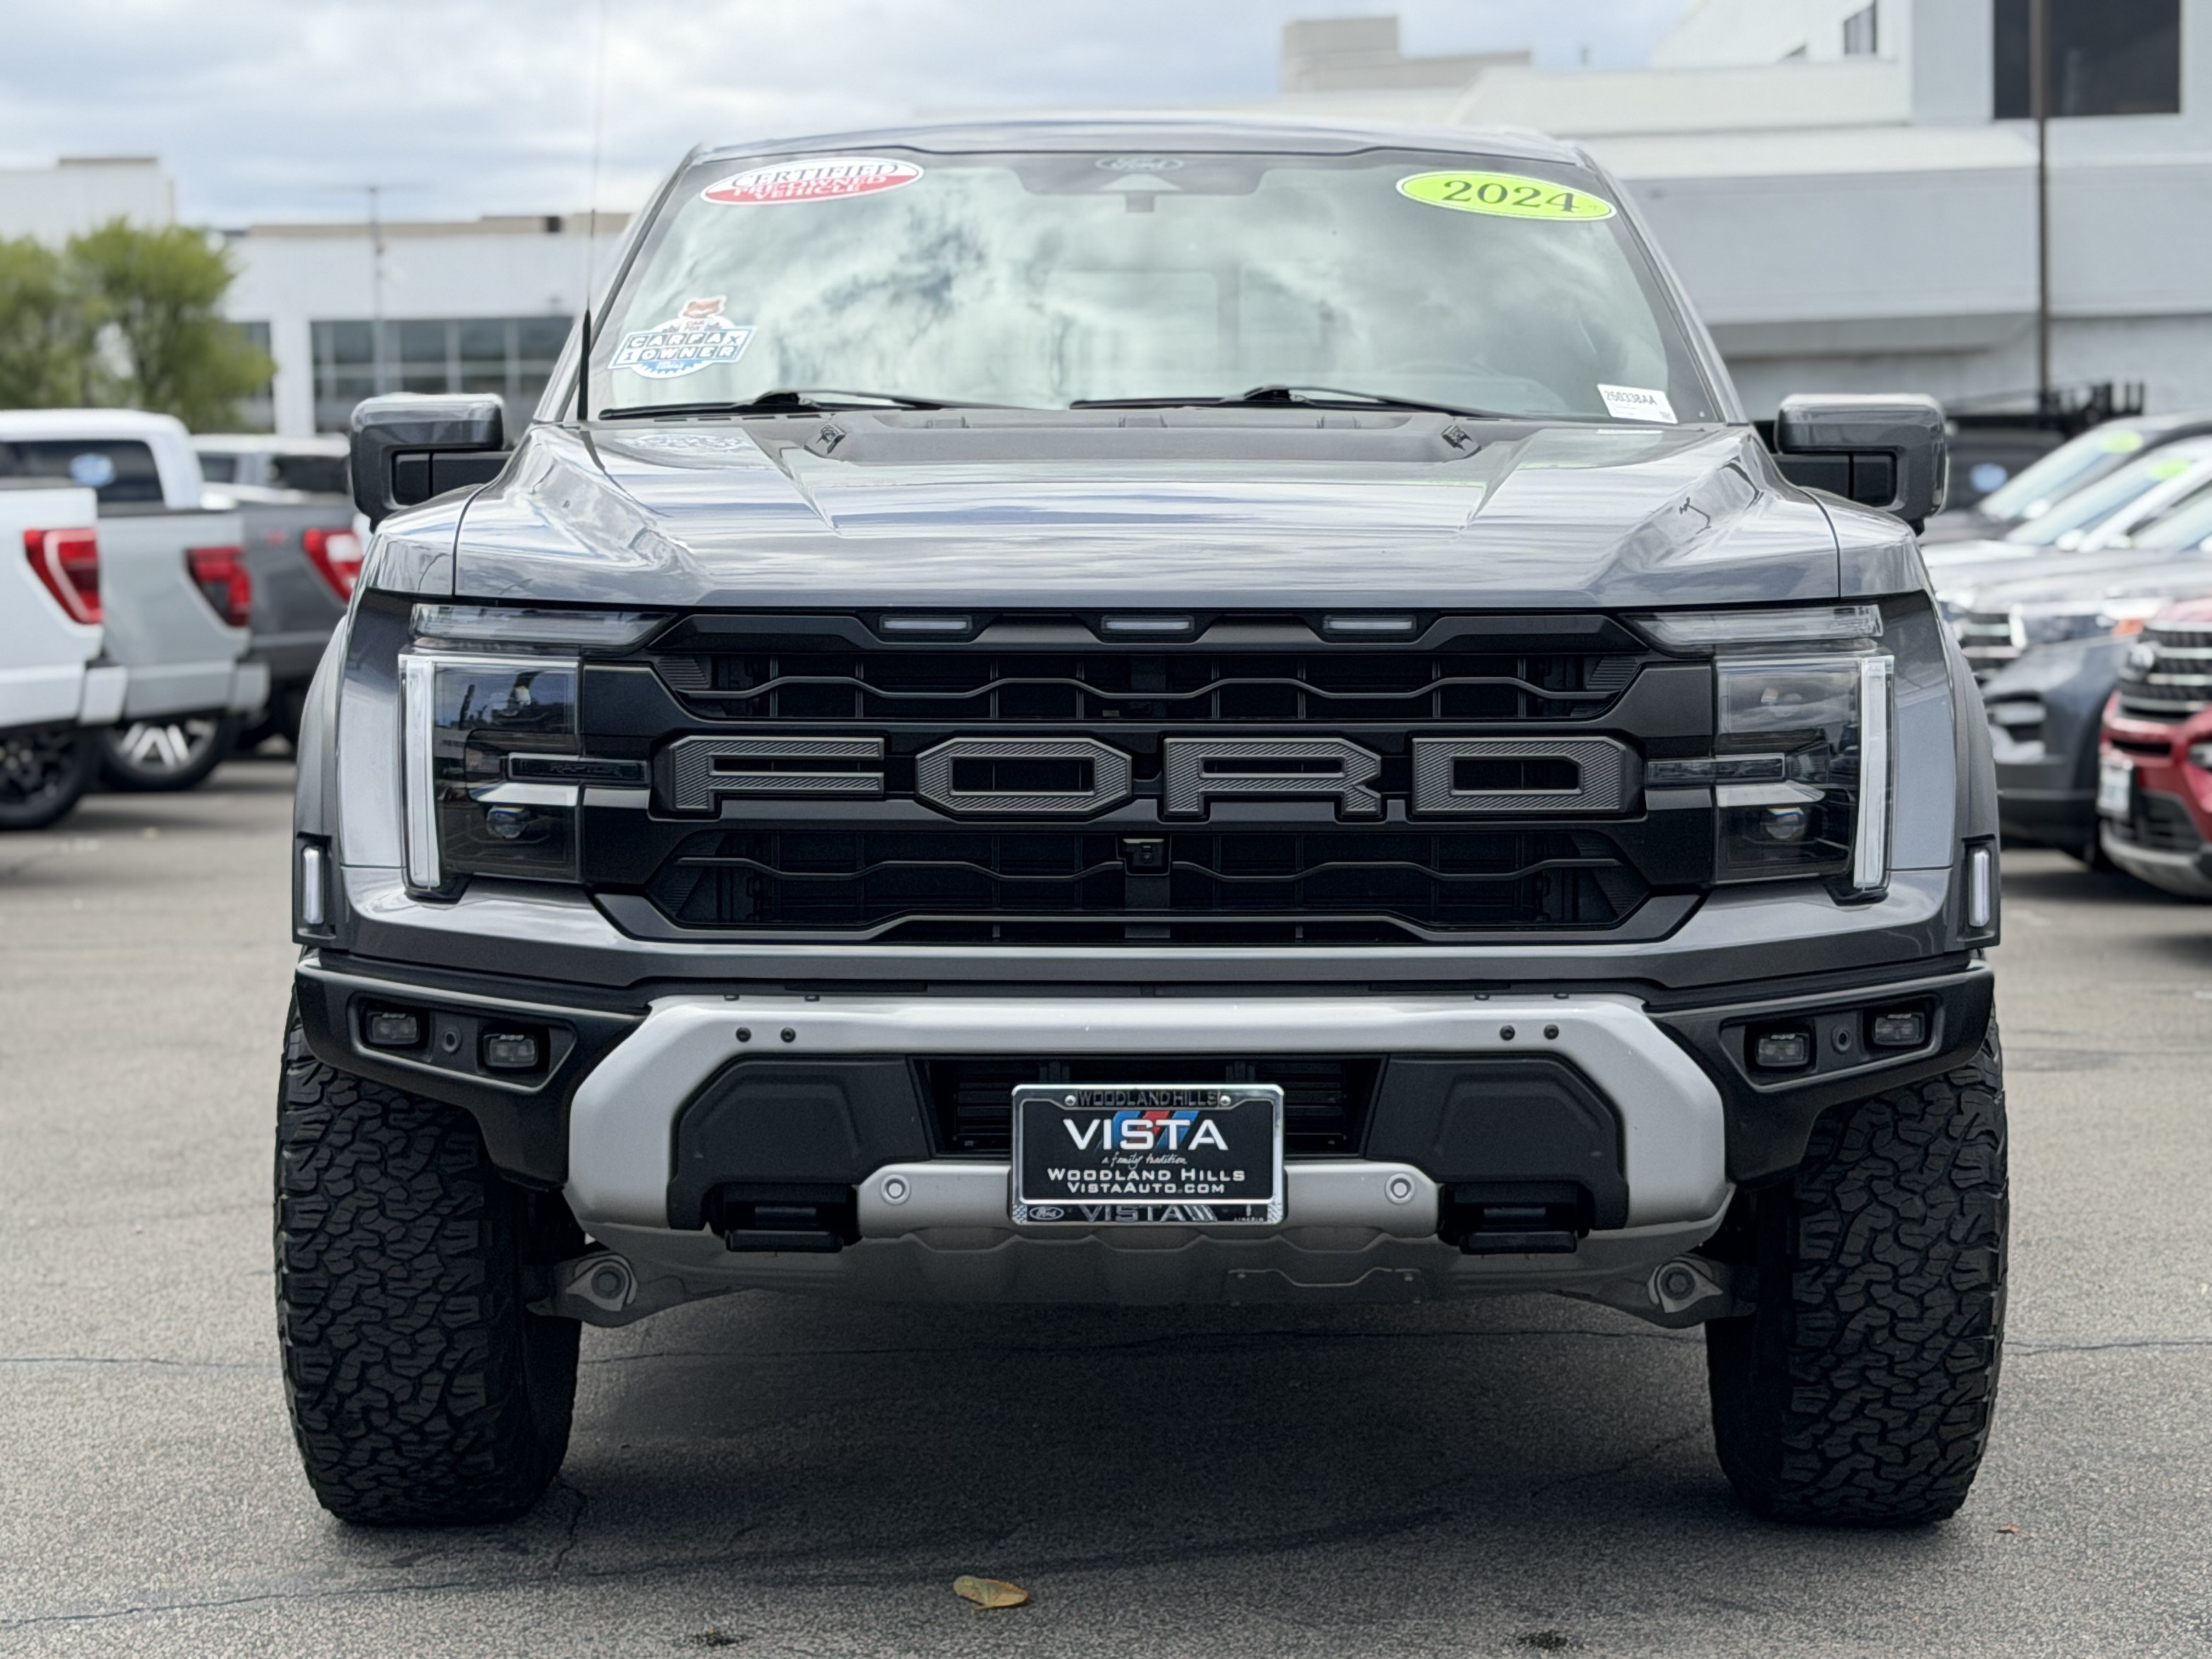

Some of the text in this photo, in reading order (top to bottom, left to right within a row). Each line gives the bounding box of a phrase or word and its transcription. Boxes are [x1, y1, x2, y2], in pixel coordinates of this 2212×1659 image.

[731, 164, 899, 189] CERTIFIED
[755, 183, 861, 200] VEHICLE
[1442, 180, 1580, 213] 2024
[630, 332, 741, 348] CARFAX
[624, 346, 735, 360] 1 OWNER
[672, 736, 1627, 814] FORD
[1079, 1091, 1218, 1106] WOODLAND HILLS
[1063, 1119, 1228, 1150] VISTA
[1110, 1152, 1143, 1170] family
[1146, 1153, 1187, 1164] tradition
[1047, 1168, 1245, 1181] WOODLAND HILLS
[1079, 1205, 1186, 1222] VISTA
